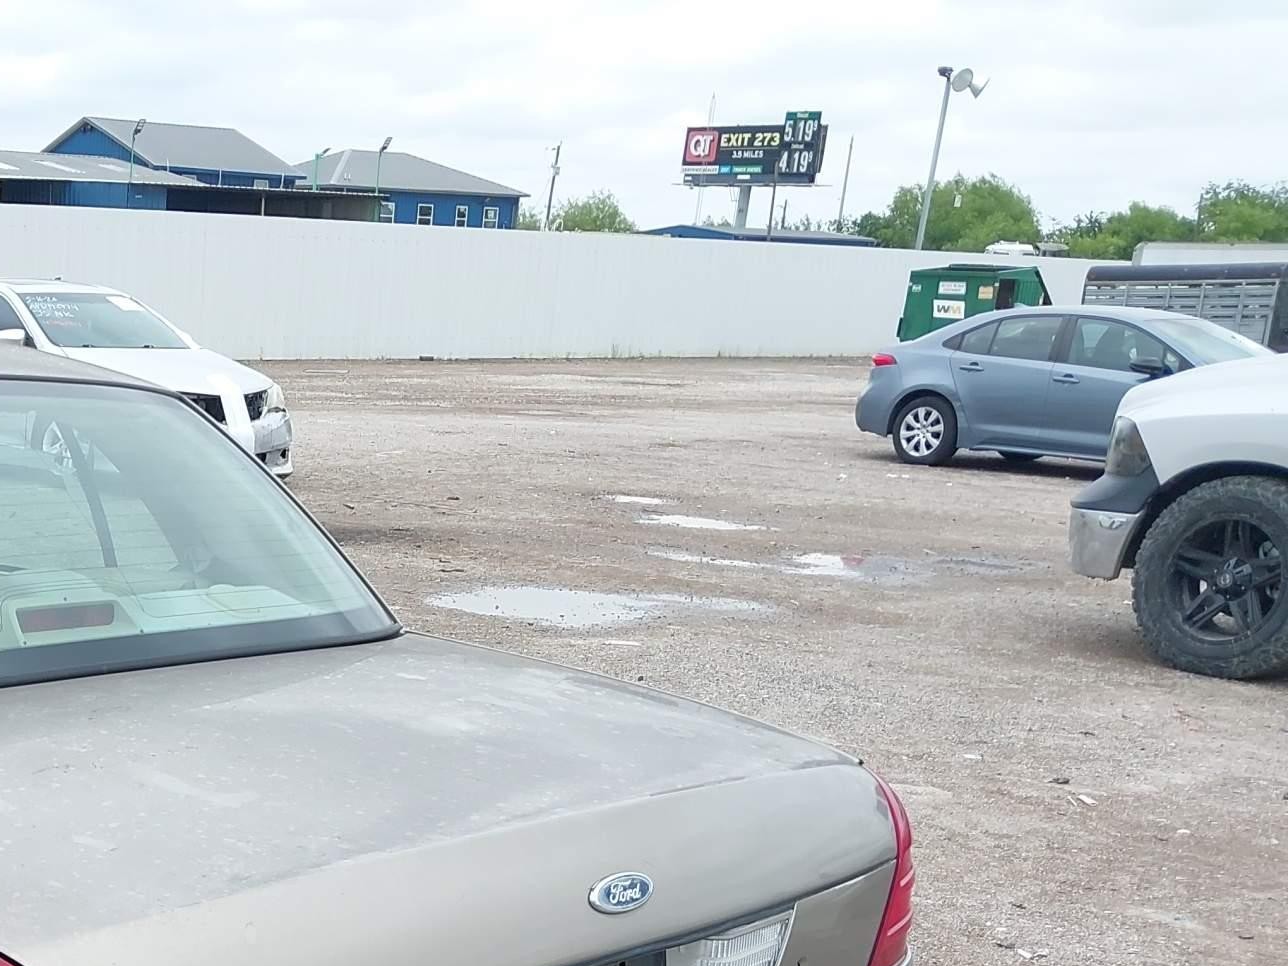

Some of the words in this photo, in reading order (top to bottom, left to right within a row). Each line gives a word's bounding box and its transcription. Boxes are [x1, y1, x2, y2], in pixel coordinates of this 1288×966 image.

[689, 135, 713, 156] QT
[720, 133, 751, 147] EXIT
[753, 132, 780, 146] 273
[743, 150, 764, 158] MILES
[937, 304, 961, 314] WM
[609, 879, 642, 904] Ford
